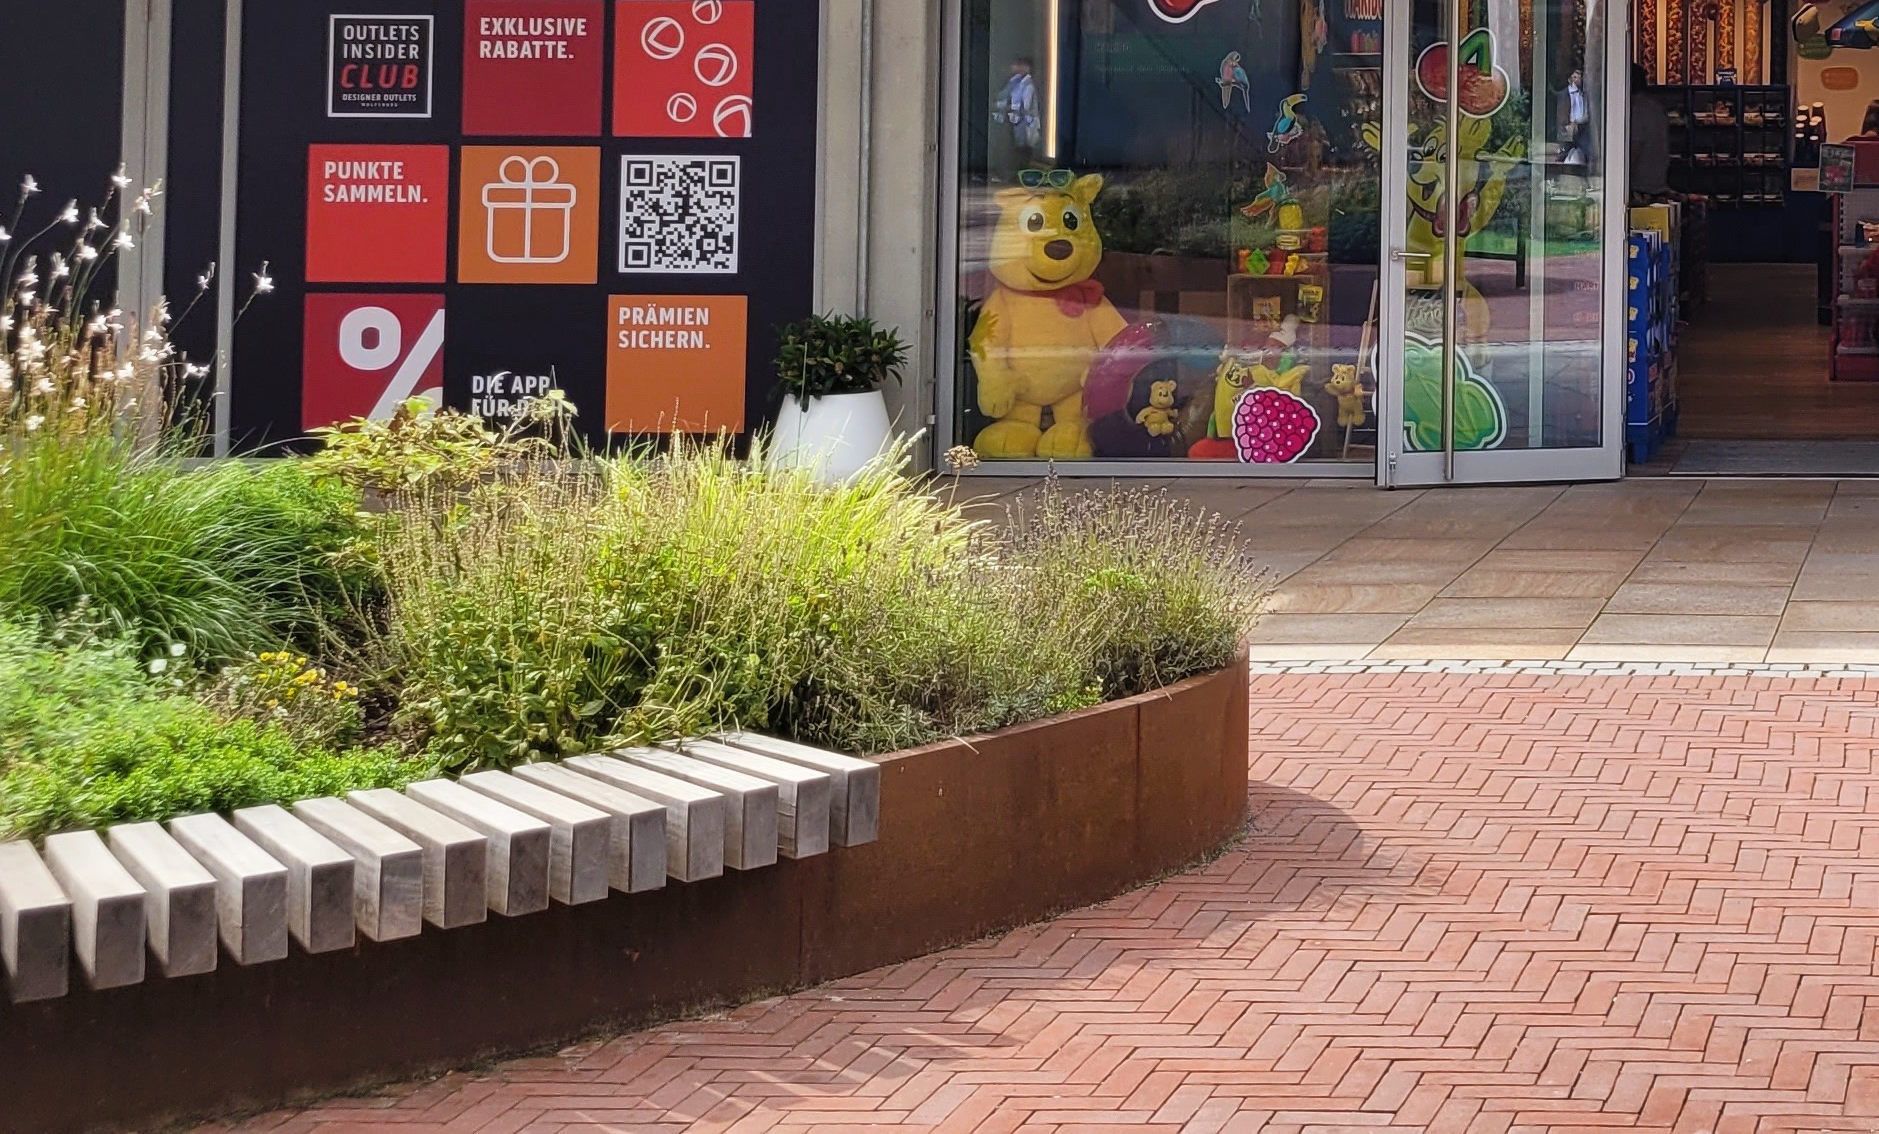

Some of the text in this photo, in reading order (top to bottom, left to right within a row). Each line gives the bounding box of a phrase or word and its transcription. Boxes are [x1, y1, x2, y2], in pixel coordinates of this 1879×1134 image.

[343, 25, 420, 41] OUTLETS
[480, 17, 587, 36] EXKLUSIVE
[343, 44, 420, 59] INSIDER
[480, 40, 575, 59] RABATTE.
[341, 64, 419, 89] CLUB
[342, 93, 417, 102] DESIGNER OUTLETS
[324, 161, 404, 180] PUNKTE
[323, 184, 429, 203] SAMMELN.
[619, 303, 709, 326] PRÄMIEN
[618, 330, 711, 349] SICHERN.
[472, 375, 551, 396] DIE APP
[472, 395, 510, 417] FÜR
